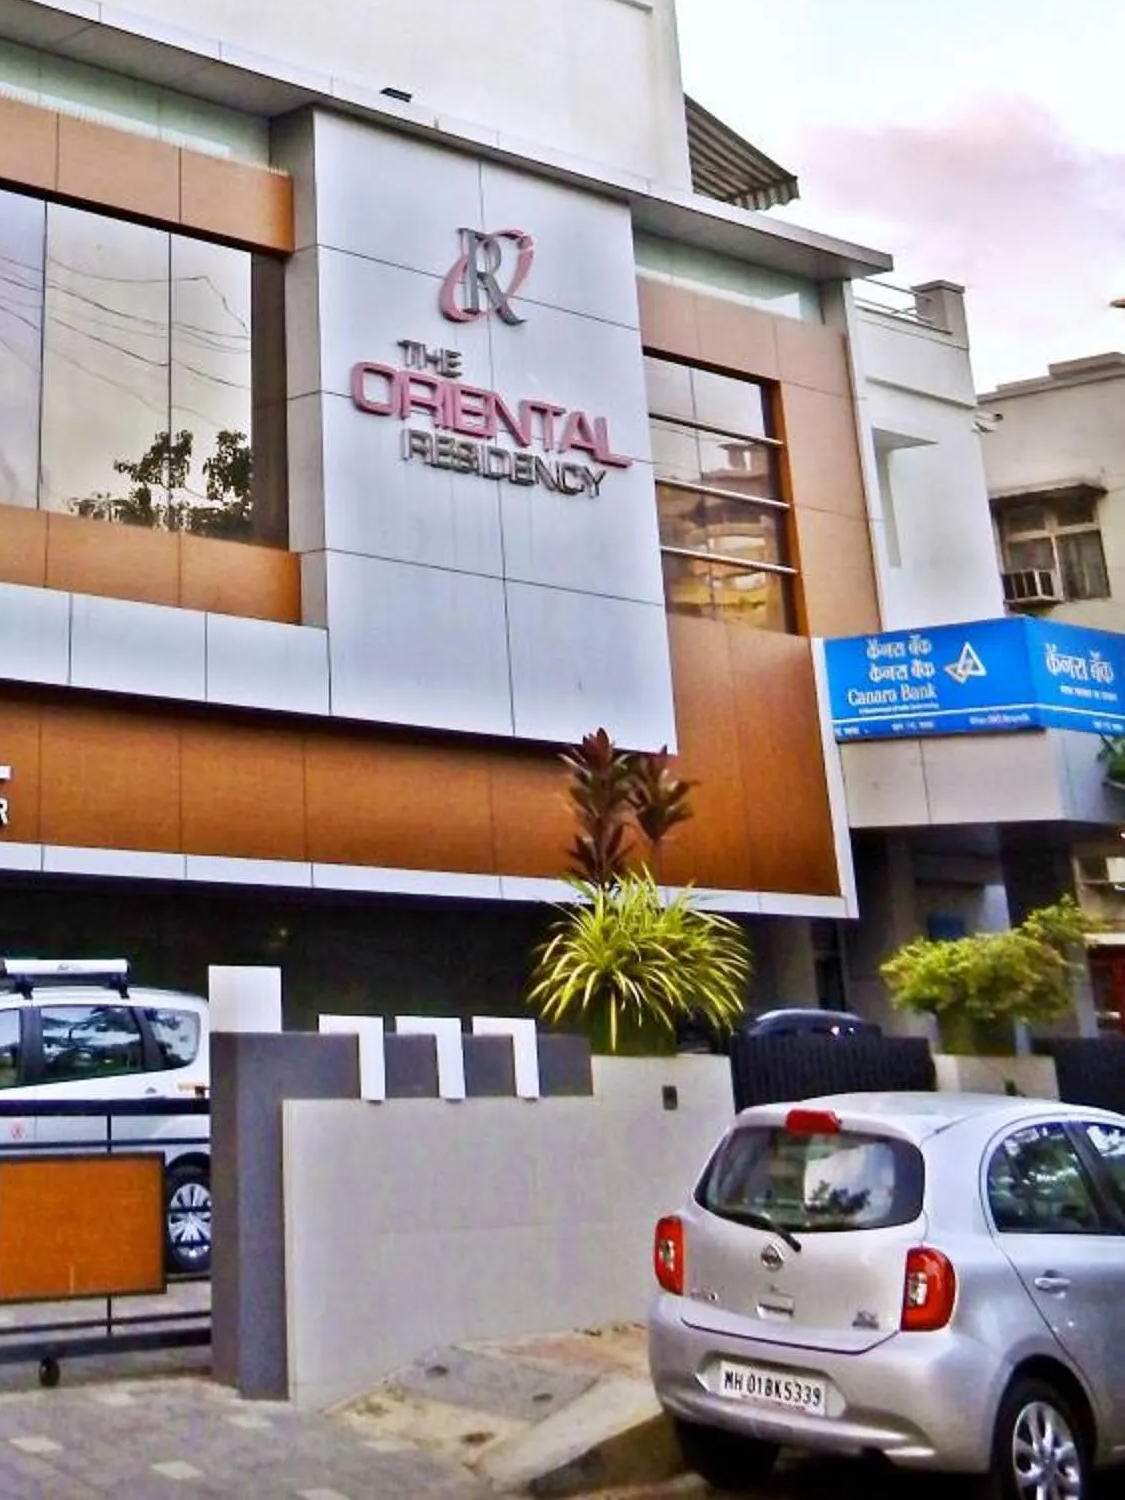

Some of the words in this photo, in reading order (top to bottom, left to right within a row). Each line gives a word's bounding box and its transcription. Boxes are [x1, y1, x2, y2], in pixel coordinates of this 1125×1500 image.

[396, 338, 463, 379] THE
[350, 361, 633, 469] ORIENTAL
[401, 427, 607, 499] RESIDENCY
[848, 687, 898, 706] Canara
[900, 681, 938, 702] Bank
